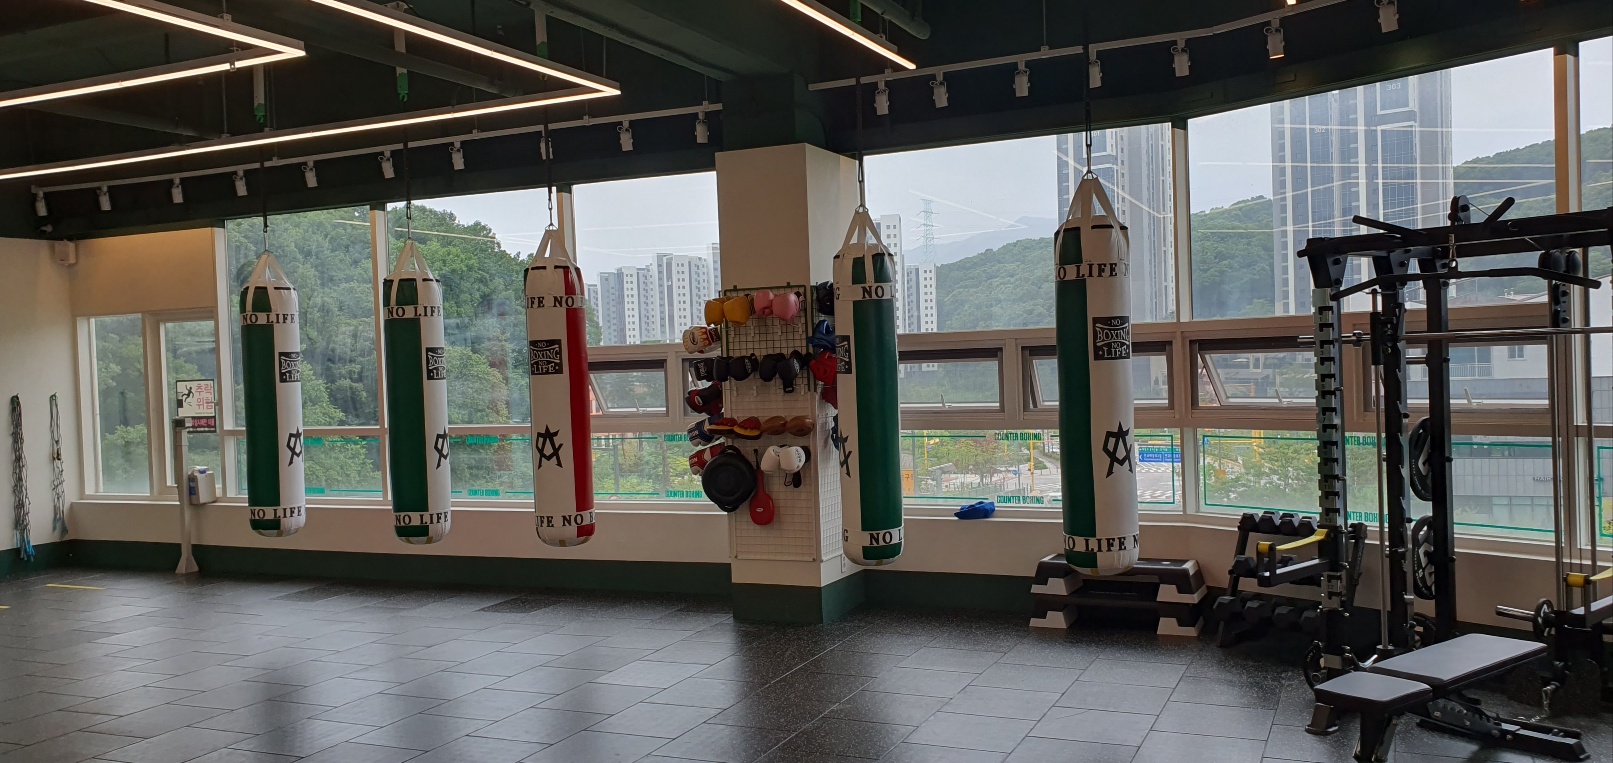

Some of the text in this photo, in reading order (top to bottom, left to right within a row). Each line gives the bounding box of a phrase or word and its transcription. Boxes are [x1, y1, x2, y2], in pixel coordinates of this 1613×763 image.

[1055, 266, 1067, 280] O
[1075, 263, 1118, 279] LIFE
[861, 285, 885, 299] NO
[526, 296, 545, 308] IFE
[552, 296, 575, 307] NO
[387, 305, 442, 318] NO LIFE
[242, 313, 296, 325] NO LIFE
[1095, 327, 1130, 343] BOXING
[1102, 345, 1127, 358] LIFE
[1111, 342, 1121, 350] NO
[533, 363, 556, 374] LIFE
[195, 383, 213, 396] 추락
[995, 433, 1018, 441] COUNTER
[1345, 436, 1361, 446] NTER
[996, 496, 1020, 504] COUNTER
[250, 506, 302, 519] NO LIFE
[395, 512, 449, 525] NO LIFE
[1347, 511, 1362, 521] NTER
[536, 515, 555, 528] IFE
[561, 513, 584, 527] NO
[868, 531, 893, 546] NO
[1084, 537, 1127, 553] LIFE
